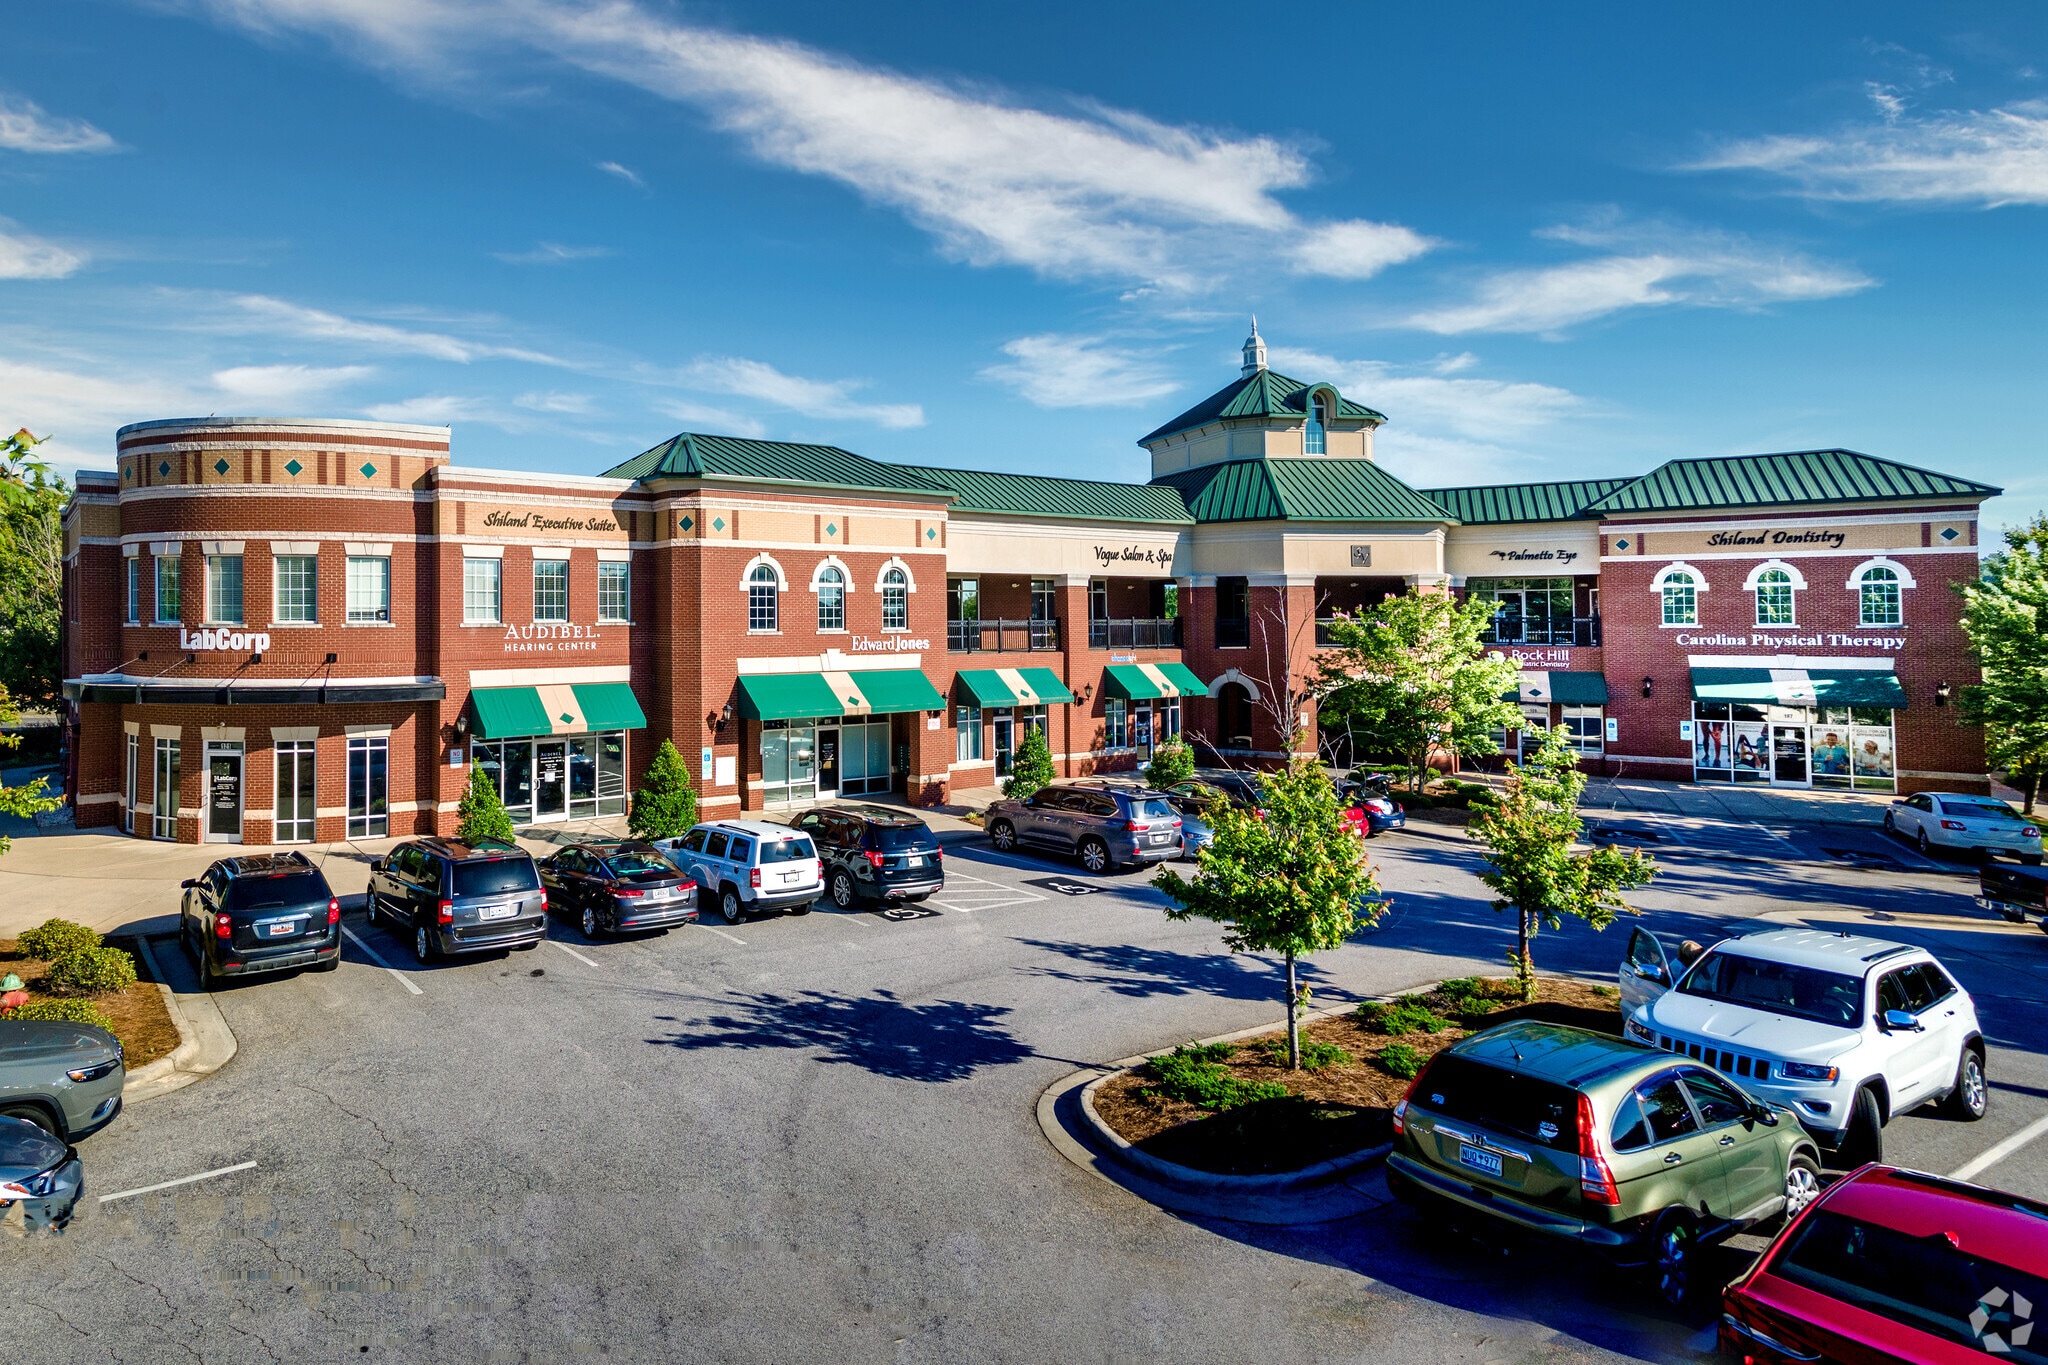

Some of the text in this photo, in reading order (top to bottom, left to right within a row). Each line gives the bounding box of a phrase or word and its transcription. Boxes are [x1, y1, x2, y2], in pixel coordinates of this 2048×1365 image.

[483, 511, 617, 532] Shiland Executive Suites
[1707, 530, 1845, 549] Shiland Dentistry
[1093, 545, 1172, 569] Vogue Salon & Spa
[1507, 549, 1578, 565] Palmetto Eye
[181, 628, 270, 654] LabCorp
[504, 641, 597, 652] HEARING CENTER
[1676, 633, 1907, 650] Carolina Physical Therapy
[1512, 649, 1570, 661] Rock Hill
[1484, 1155, 1499, 1169] 977
